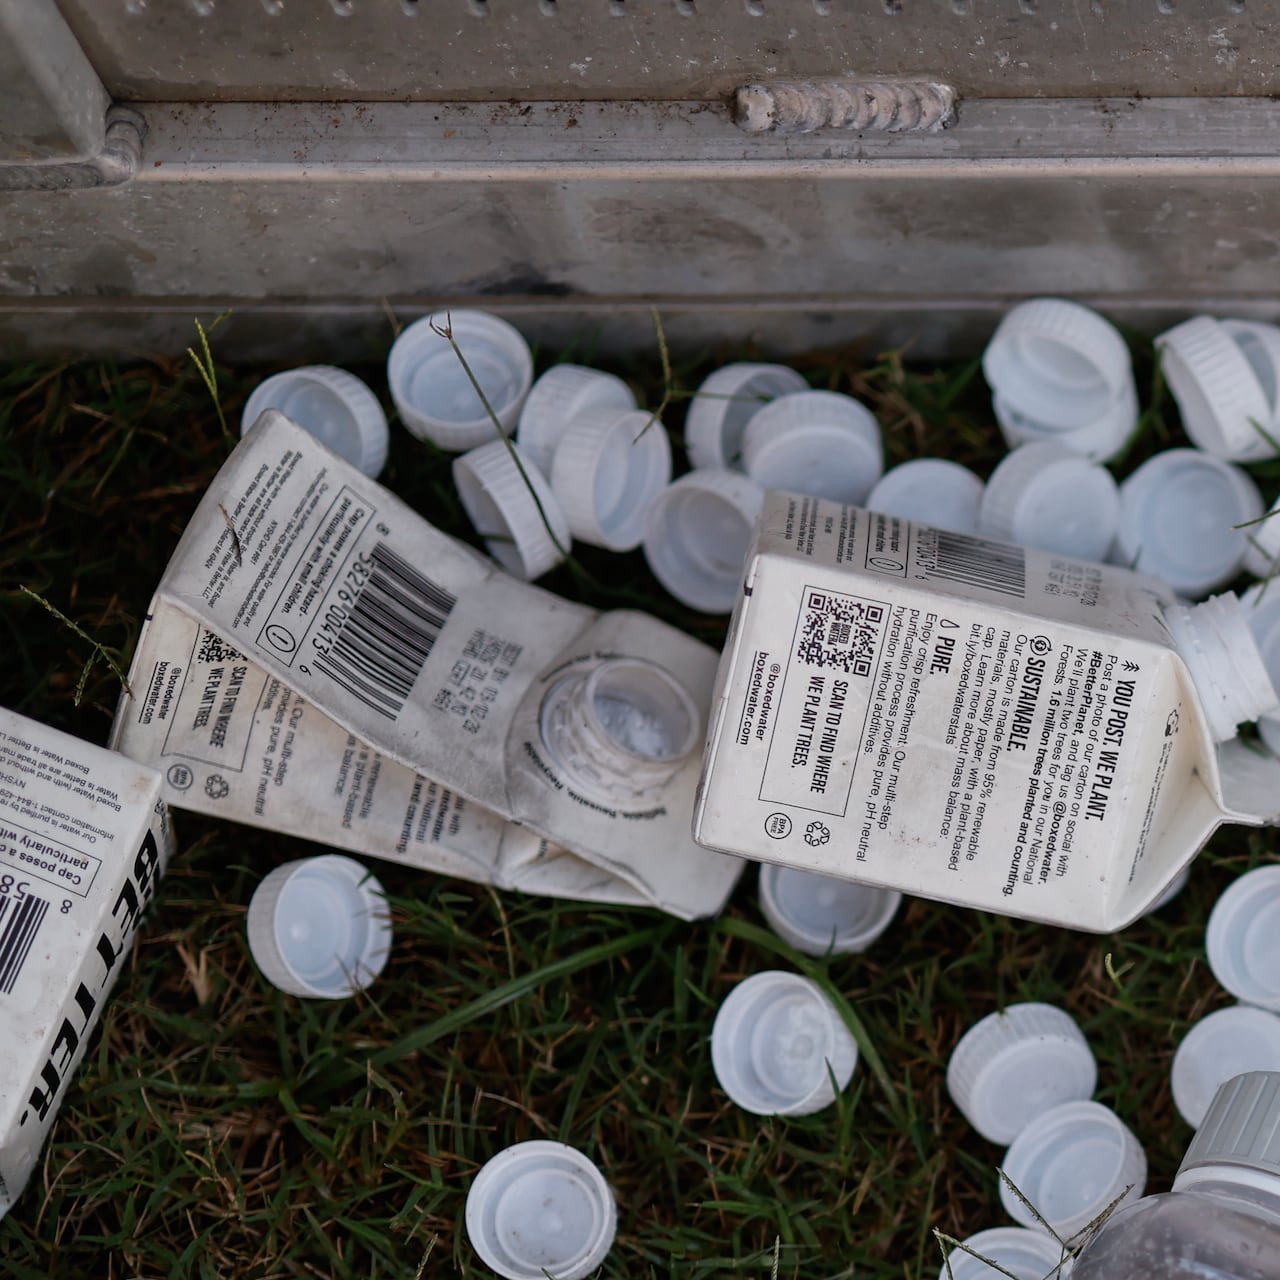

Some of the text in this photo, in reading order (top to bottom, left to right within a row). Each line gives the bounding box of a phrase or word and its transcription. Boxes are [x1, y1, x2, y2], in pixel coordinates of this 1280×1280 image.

[280, 497, 352, 614] particularly with small children.
[298, 556, 334, 616] choking hazard
[311, 603, 351, 655] 00413
[826, 618, 842, 644] WATER
[837, 620, 853, 645] BOXED
[928, 635, 956, 675] PURE.
[142, 660, 171, 725] boxedwater.com
[157, 666, 182, 720] @boxedwater
[199, 666, 225, 708] WE PLANT
[223, 683, 241, 696] TO
[227, 665, 248, 686] SCAN
[298, 663, 312, 677] 6
[739, 650, 769, 746] boxedwater.com
[862, 604, 907, 756] hydration without additives.
[944, 622, 983, 749] bit.ly/boxedwaterstats
[754, 662, 781, 741] @boxedwater
[790, 675, 825, 768] WE PLANT TREES.
[875, 611, 938, 830] Enjoy crisp refreshment. Our multi-step
[1005, 656, 1046, 752] SUSTAINABLE.
[6, 735, 90, 775] Boxed Water is Better
[809, 678, 849, 794] SCAN TO FIND WHERE
[854, 607, 920, 862] purification process provides pure, pH neutral
[938, 626, 996, 839] cap. Learn more about mass balance:
[946, 629, 1011, 871] materials, mostly paper, with a plant-based
[964, 633, 1028, 861] Our carton is made from 95% renewable
[1083, 679, 1136, 821] YOU POST. WE PLANT.
[5, 758, 122, 813] Boxed Water and without
[15, 752, 118, 801] Water is Better are all trade
[1001, 643, 1074, 897] Forests. 1.6 million trees planted and counting.
[1022, 647, 1089, 885] We'll plant two trees for you in our National
[1037, 649, 1103, 885] #BetterPlanet, and tag us @boxedwater.
[1054, 653, 1118, 877] Post a photo of our carton on social with
[6, 799, 97, 844] Our water is purified by
[39, 803, 115, 842] information contact
[767, 813, 779, 835] FREE
[775, 815, 789, 838] BPA
[7, 847, 82, 885] Cap poses a
[18, 834, 89, 870] particularly
[59, 898, 73, 914] 8
